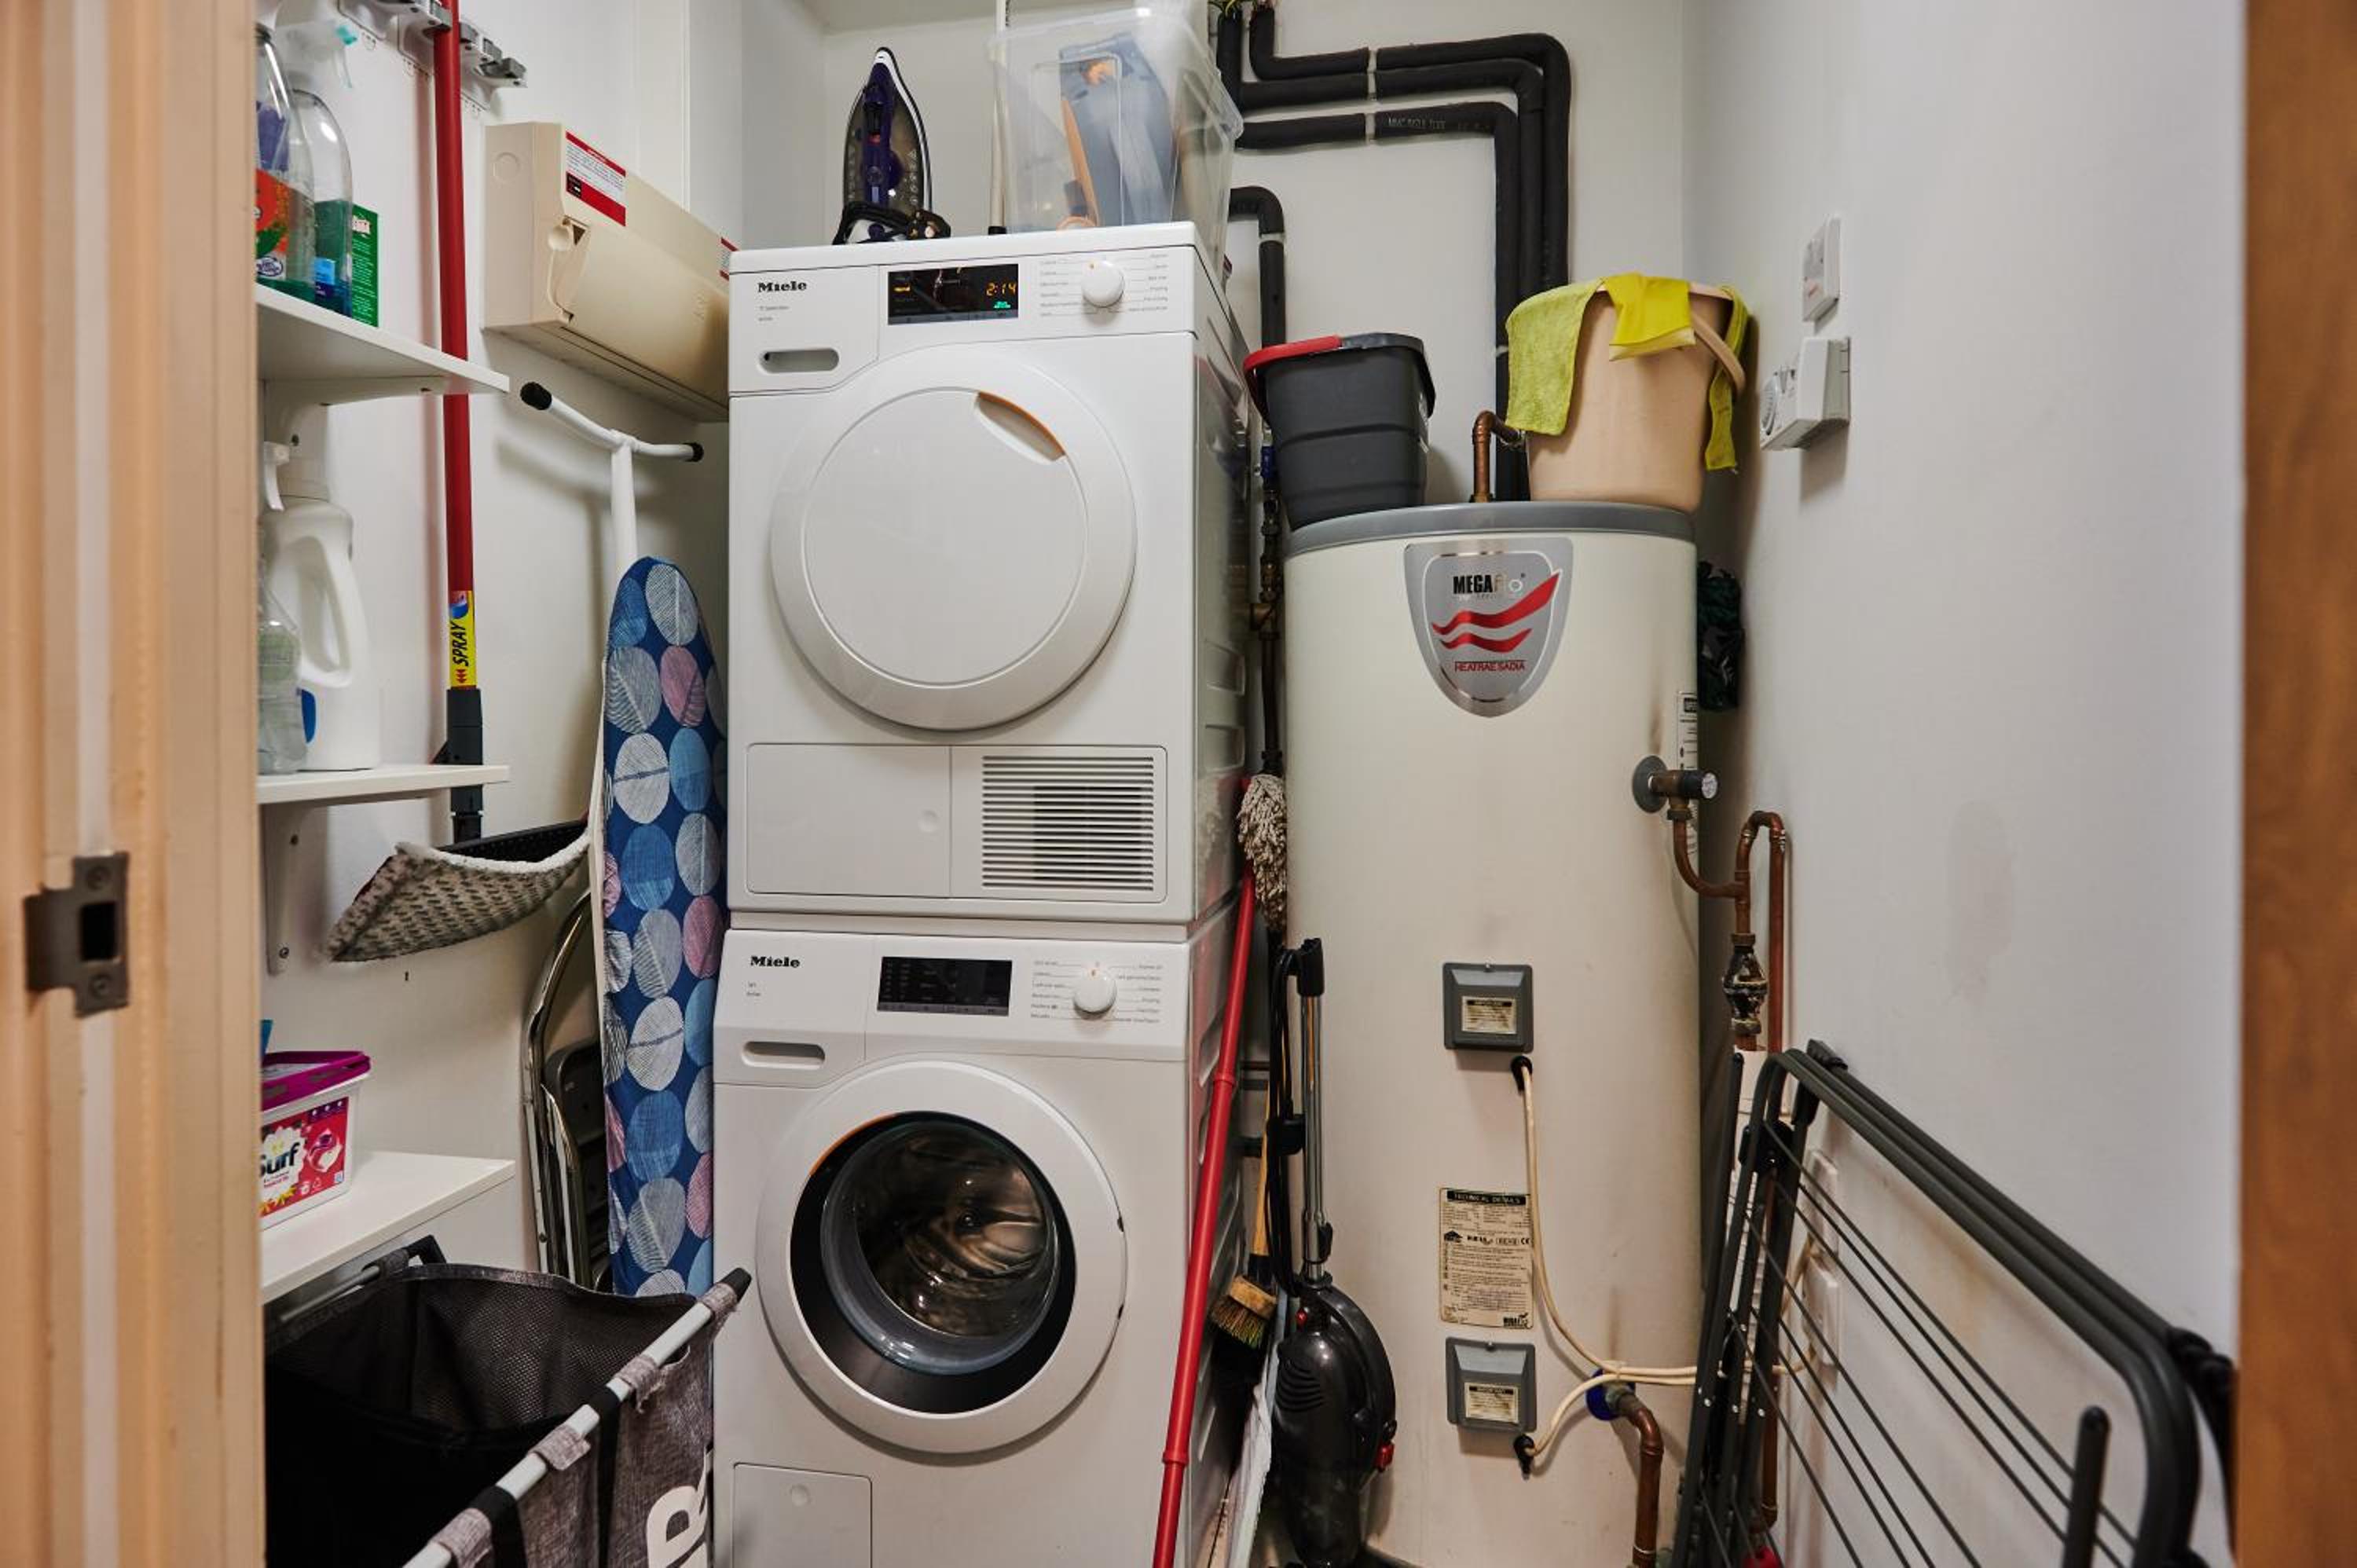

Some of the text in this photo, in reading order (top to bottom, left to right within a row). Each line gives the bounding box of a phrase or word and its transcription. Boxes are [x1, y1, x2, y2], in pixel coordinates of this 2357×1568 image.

[757, 280, 807, 293] Miele
[986, 283, 1017, 296] 2:14
[450, 621, 469, 666] SPRAY
[750, 955, 801, 968] Miele
